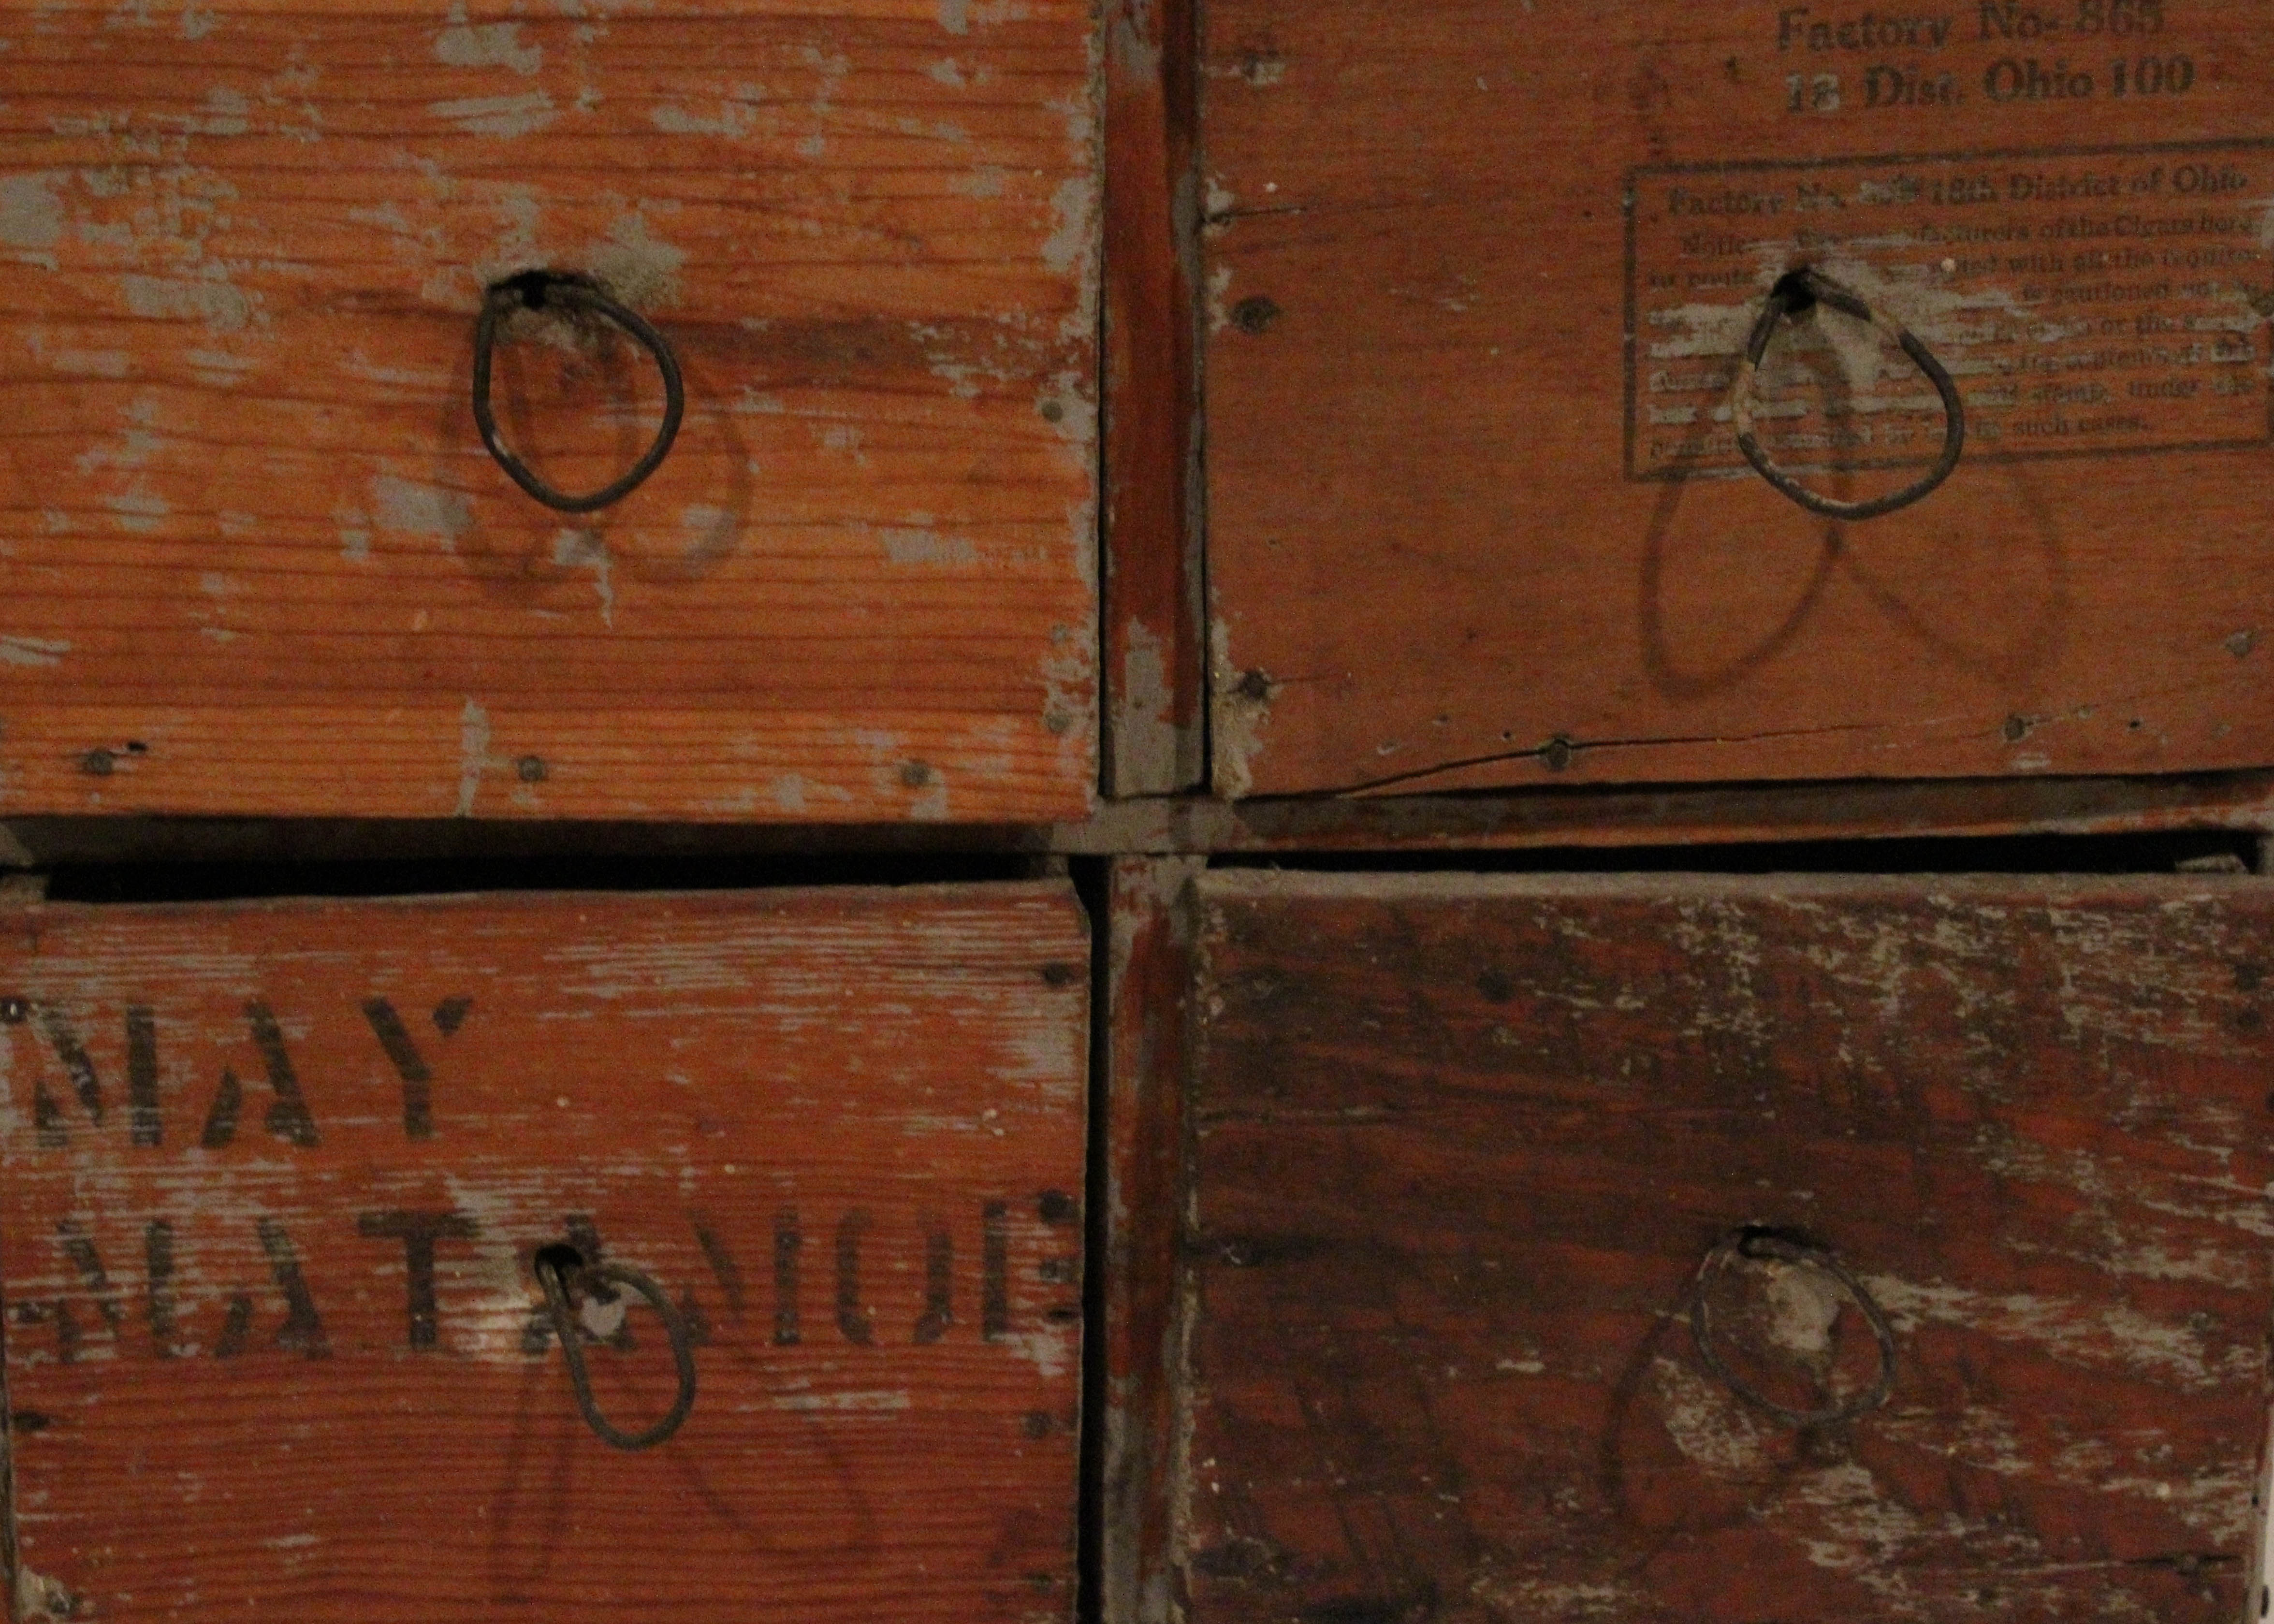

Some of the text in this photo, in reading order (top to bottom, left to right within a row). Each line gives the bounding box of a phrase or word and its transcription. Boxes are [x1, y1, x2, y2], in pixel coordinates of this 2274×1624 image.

[1776, 7, 1953, 52] Factory
[1985, 56, 2094, 102] Ohio
[2111, 53, 2194, 98] 100
[2171, 163, 2249, 194] Ohio
